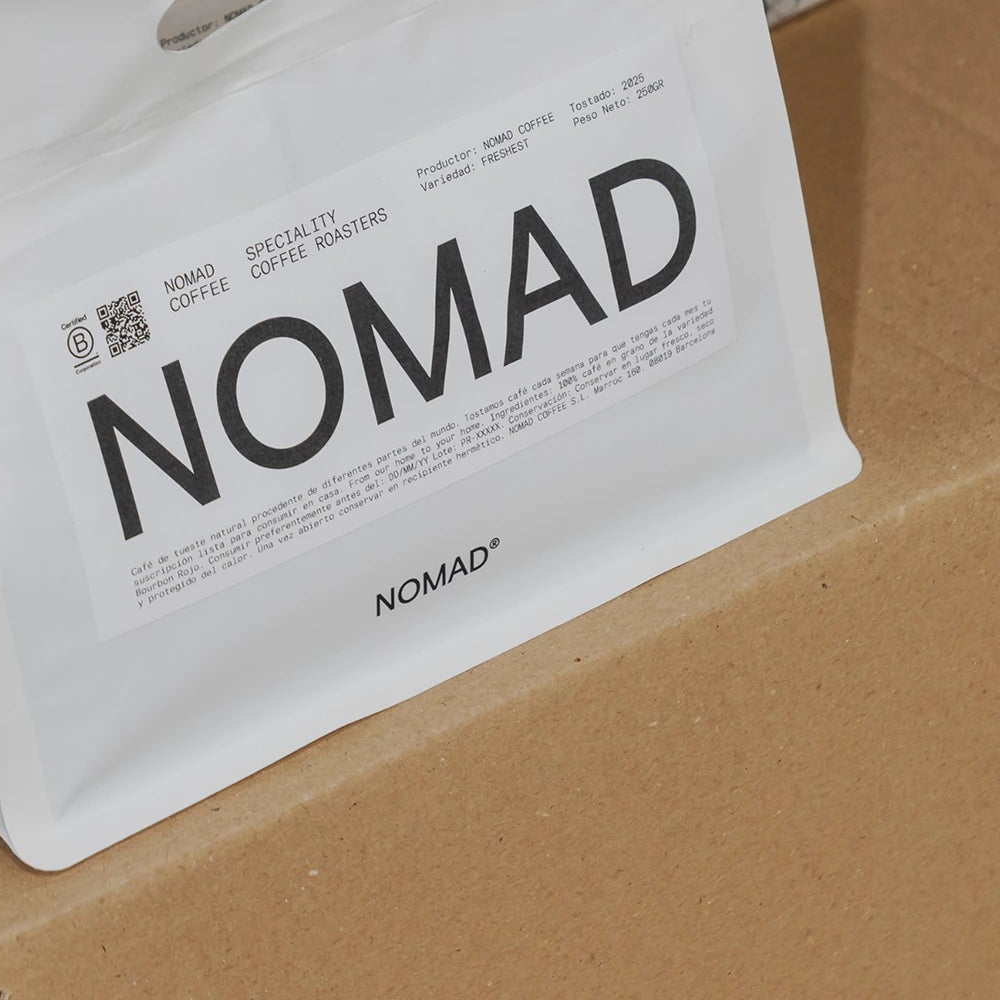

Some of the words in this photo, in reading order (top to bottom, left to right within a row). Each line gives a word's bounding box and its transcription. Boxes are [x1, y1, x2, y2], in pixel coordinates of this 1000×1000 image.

[569, 88, 616, 113] Tostado:
[621, 72, 645, 91] 2025
[572, 111, 598, 128] Peso
[601, 96, 631, 115] Neto:
[636, 79, 665, 100] 250GR
[416, 147, 478, 179] Productor:
[482, 130, 513, 151] NOMAD
[518, 112, 555, 135] COFFEE
[420, 163, 476, 193] Variedad:
[481, 138, 530, 167] FRESHEST
[245, 209, 336, 261] SPECIALITY
[250, 244, 308, 279] COFFEE
[315, 207, 388, 251] ROASTERS
[163, 263, 215, 294] NOMAD
[169, 277, 231, 312] COFFEE
[61, 313, 88, 331] Certified
[87, 158, 697, 542] NOMAD
[130, 560, 153, 576] Café
[157, 555, 168, 564] de
[173, 538, 206, 557] tueste
[210, 518, 247, 541] natural
[250, 493, 303, 524] procedente
[306, 486, 318, 496] de
[321, 461, 372, 489] diferentes
[376, 445, 407, 465] partes
[411, 434, 426, 448] del
[429, 421, 459, 439] mundo.
[463, 399, 504, 422] Tostamos
[507, 386, 528, 402] café
[531, 376, 552, 391] cada
[555, 361, 585, 380] semana
[587, 350, 608, 366] para
[611, 340, 626, 352] que
[630, 324, 658, 343] tengas
[661, 313, 681, 328] cada
[683, 304, 698, 316] mes
[701, 298, 712, 307] tu
[133, 555, 193, 587] suscripción
[197, 541, 225, 558] lista
[229, 529, 252, 545] para
[256, 507, 297, 532] consumir
[302, 499, 314, 510] en
[348, 473, 370, 488] From
[374, 464, 389, 476] our
[394, 452, 415, 467] home
[420, 445, 431, 455] to
[435, 433, 455, 450] your
[581, 362, 601, 378] café
[605, 356, 616, 367] en
[620, 343, 645, 361] grano
[648, 336, 658, 345] de
[662, 328, 672, 339] la
[676, 305, 713, 331] variedad
[134, 575, 174, 597] Bourbon
[207, 540, 250, 565] Consumir
[254, 503, 331, 546] preferentemente
[335, 489, 361, 506] antes
[364, 478, 384, 492] del:
[431, 444, 456, 460] Lote:
[574, 367, 617, 392] Conservar
[620, 360, 632, 370] en
[634, 346, 657, 363] lugar
[696, 317, 714, 332] seco
[137, 599, 143, 608] y
[147, 576, 197, 604] protegido
[200, 565, 216, 579] del
[256, 541, 274, 553] Una
[277, 531, 293, 544] vez
[298, 513, 334, 535] abierto
[337, 489, 383, 516] conservar
[387, 482, 399, 493] en
[402, 457, 452, 485] recipiente
[508, 417, 533, 435] NOMAD
[536, 400, 567, 421] COFFEE
[592, 375, 623, 394] Marroc
[674, 327, 715, 354] Barcelona
